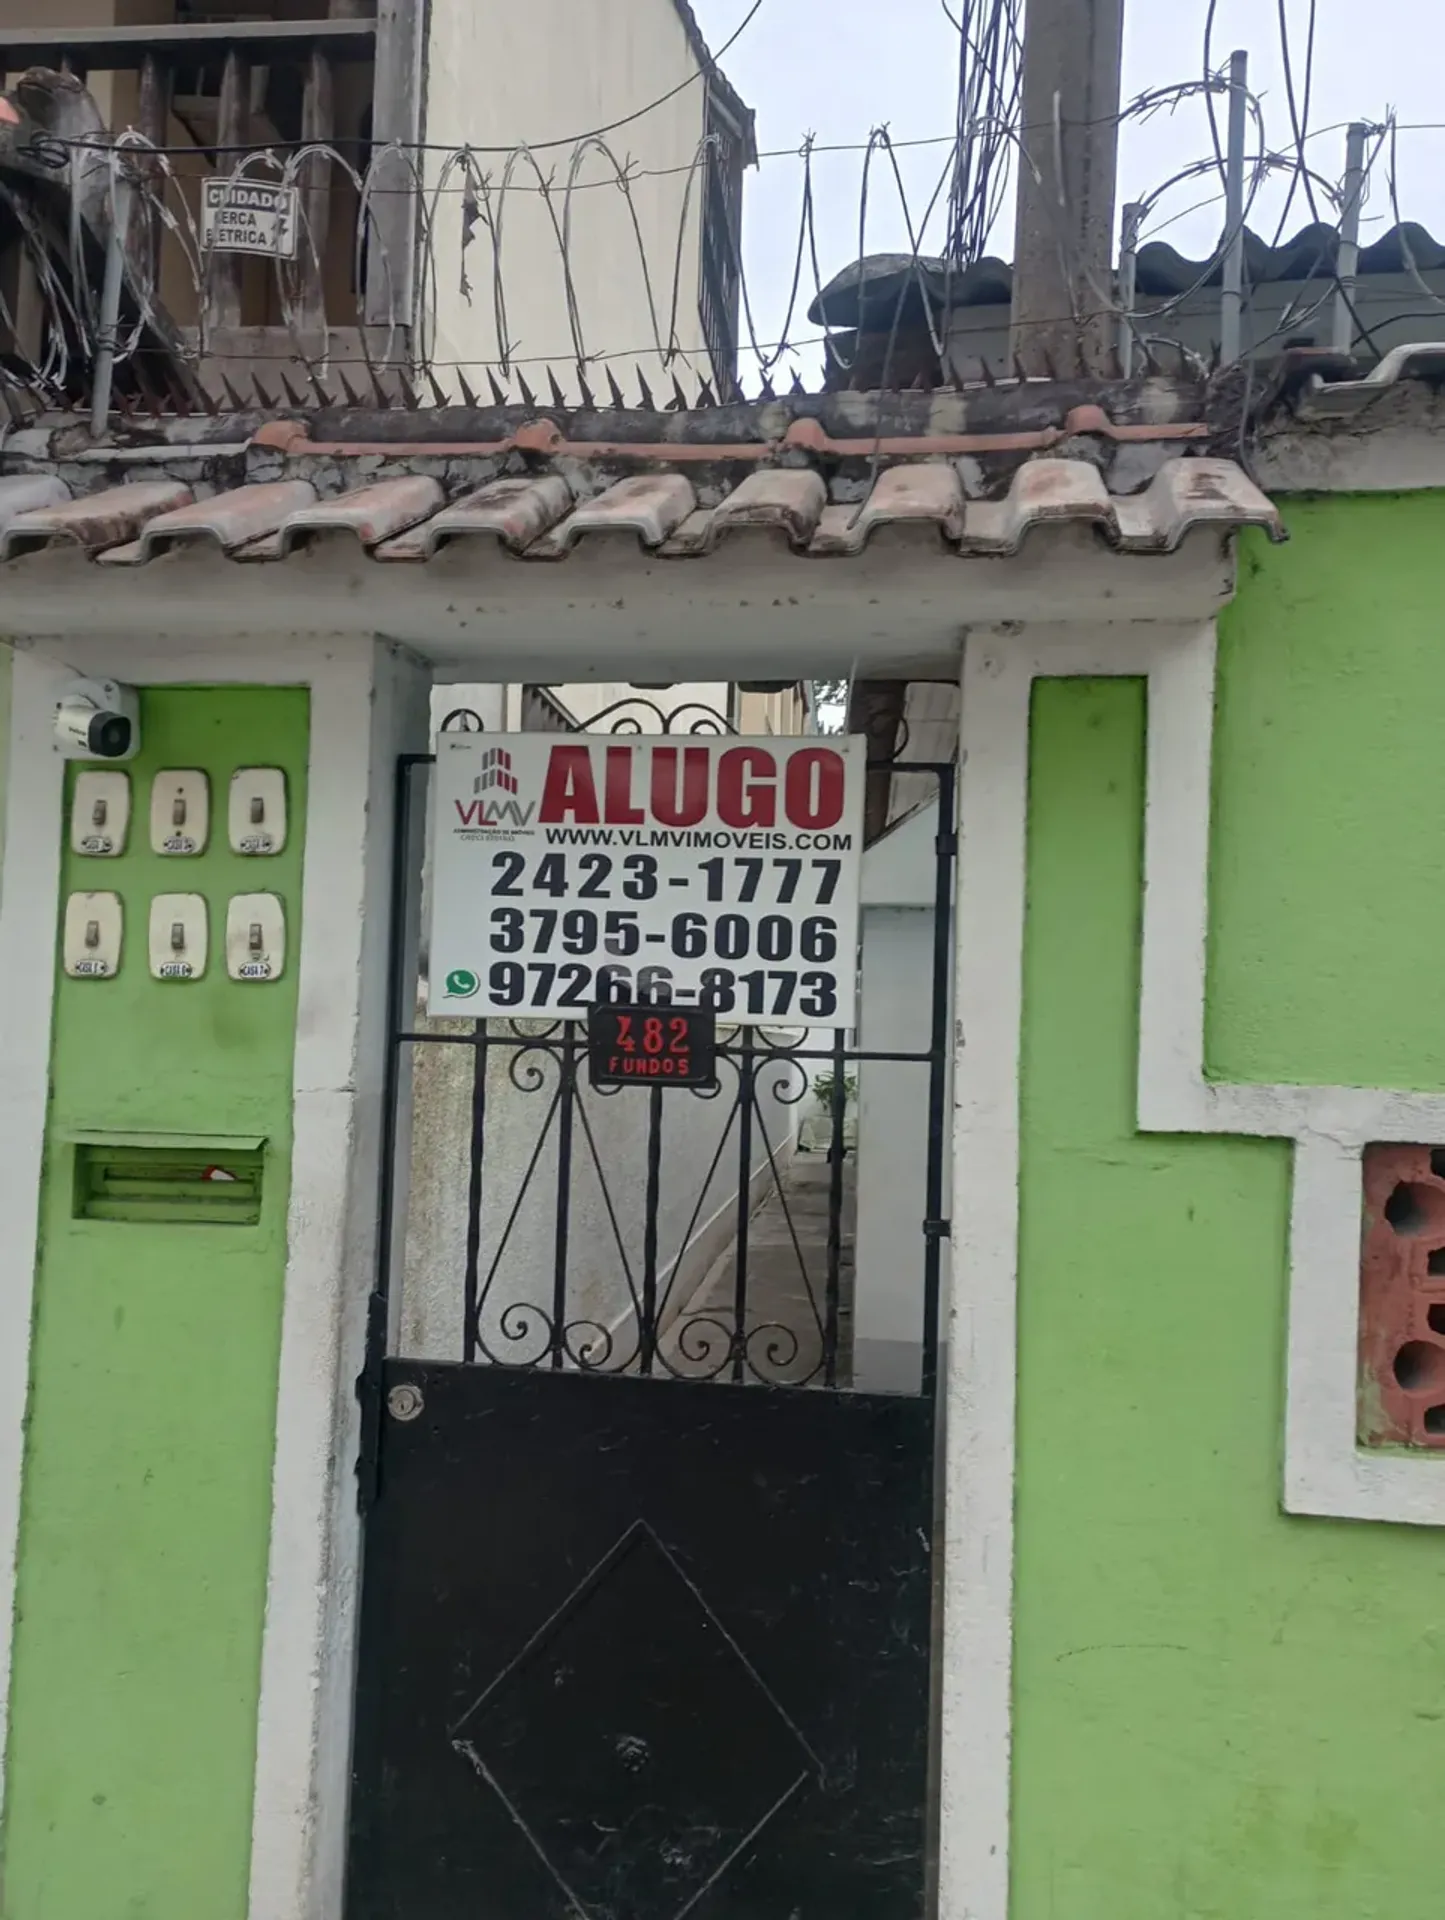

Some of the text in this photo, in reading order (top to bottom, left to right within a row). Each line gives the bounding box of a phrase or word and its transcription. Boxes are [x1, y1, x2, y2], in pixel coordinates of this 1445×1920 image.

[216, 211, 256, 226] ERCA
[206, 228, 267, 246] EETRICA
[538, 745, 845, 830] ALUGO
[454, 799, 536, 827] VLMV
[546, 828, 852, 851] WWW.VLMVIMOVEIS.COM
[491, 851, 842, 905] 2423-1777
[489, 907, 838, 963] 3795-6006
[488, 961, 838, 1018] 97266-8173
[615, 1015, 690, 1054] 482
[608, 1056, 690, 1075] FUNDOS
